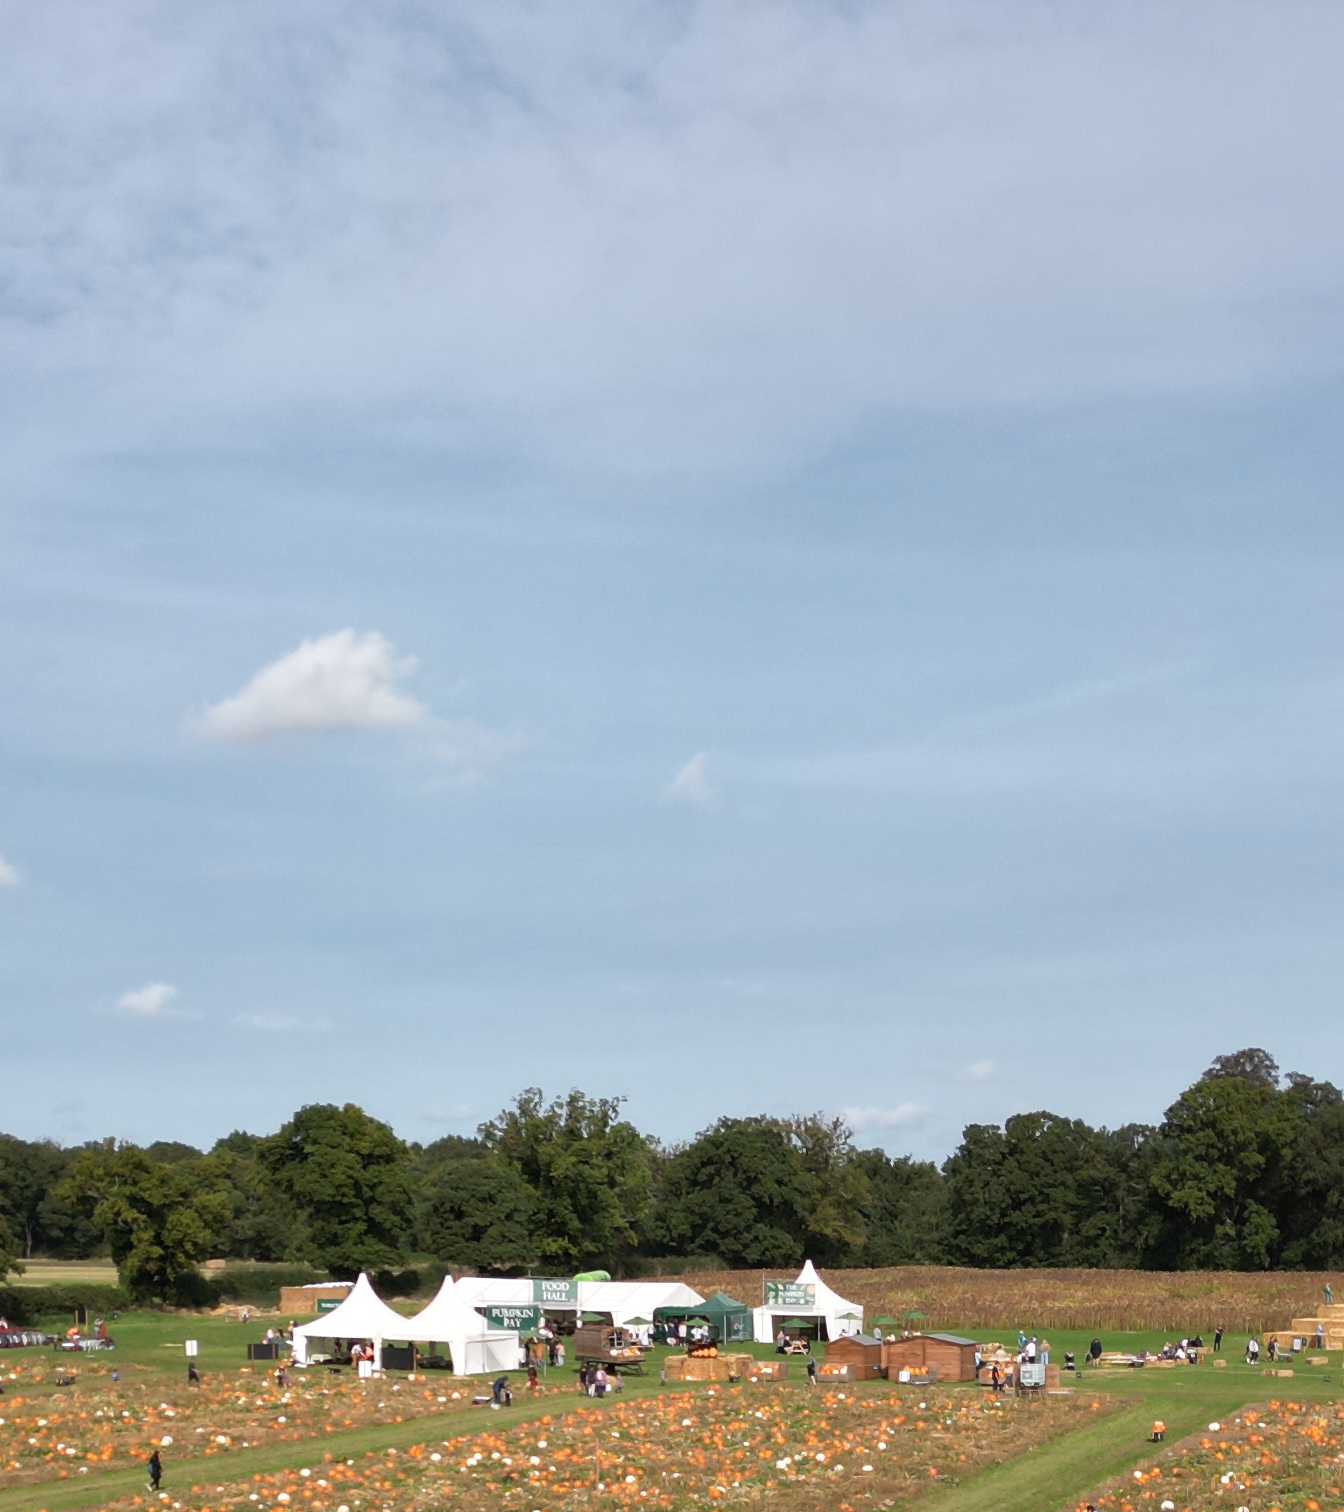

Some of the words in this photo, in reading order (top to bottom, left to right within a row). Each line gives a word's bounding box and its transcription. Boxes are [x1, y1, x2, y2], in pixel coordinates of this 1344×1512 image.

[542, 1281, 569, 1291] FOOD
[543, 1291, 568, 1301] HALL
[492, 1308, 534, 1318] PUMPKIN
[503, 1317, 522, 1328] PAY
